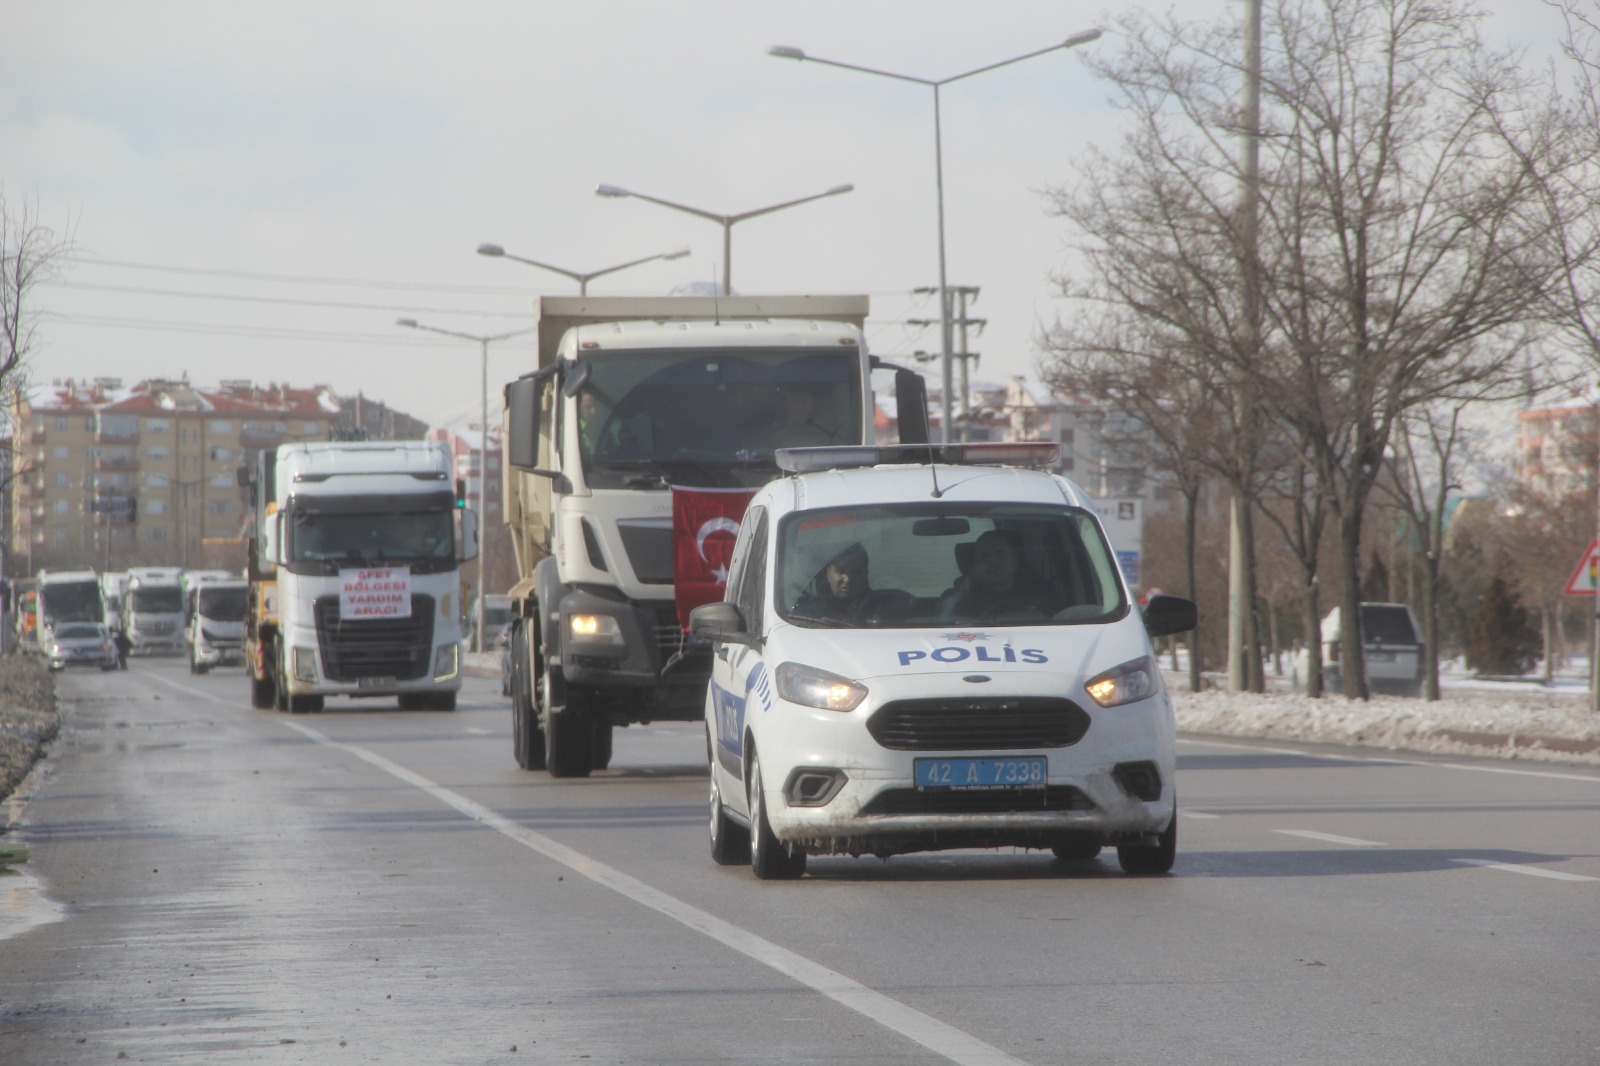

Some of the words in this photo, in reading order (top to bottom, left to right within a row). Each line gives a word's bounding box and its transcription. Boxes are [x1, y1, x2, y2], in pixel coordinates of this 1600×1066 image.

[357, 569, 392, 579] AFET
[344, 579, 406, 592] BÖLGESİ
[348, 594, 403, 604] YARDIM
[353, 605, 397, 615] ARACI
[897, 643, 1049, 666] POLİS
[928, 763, 951, 783] 42
[966, 762, 978, 782] A
[994, 761, 1041, 782] 7338
